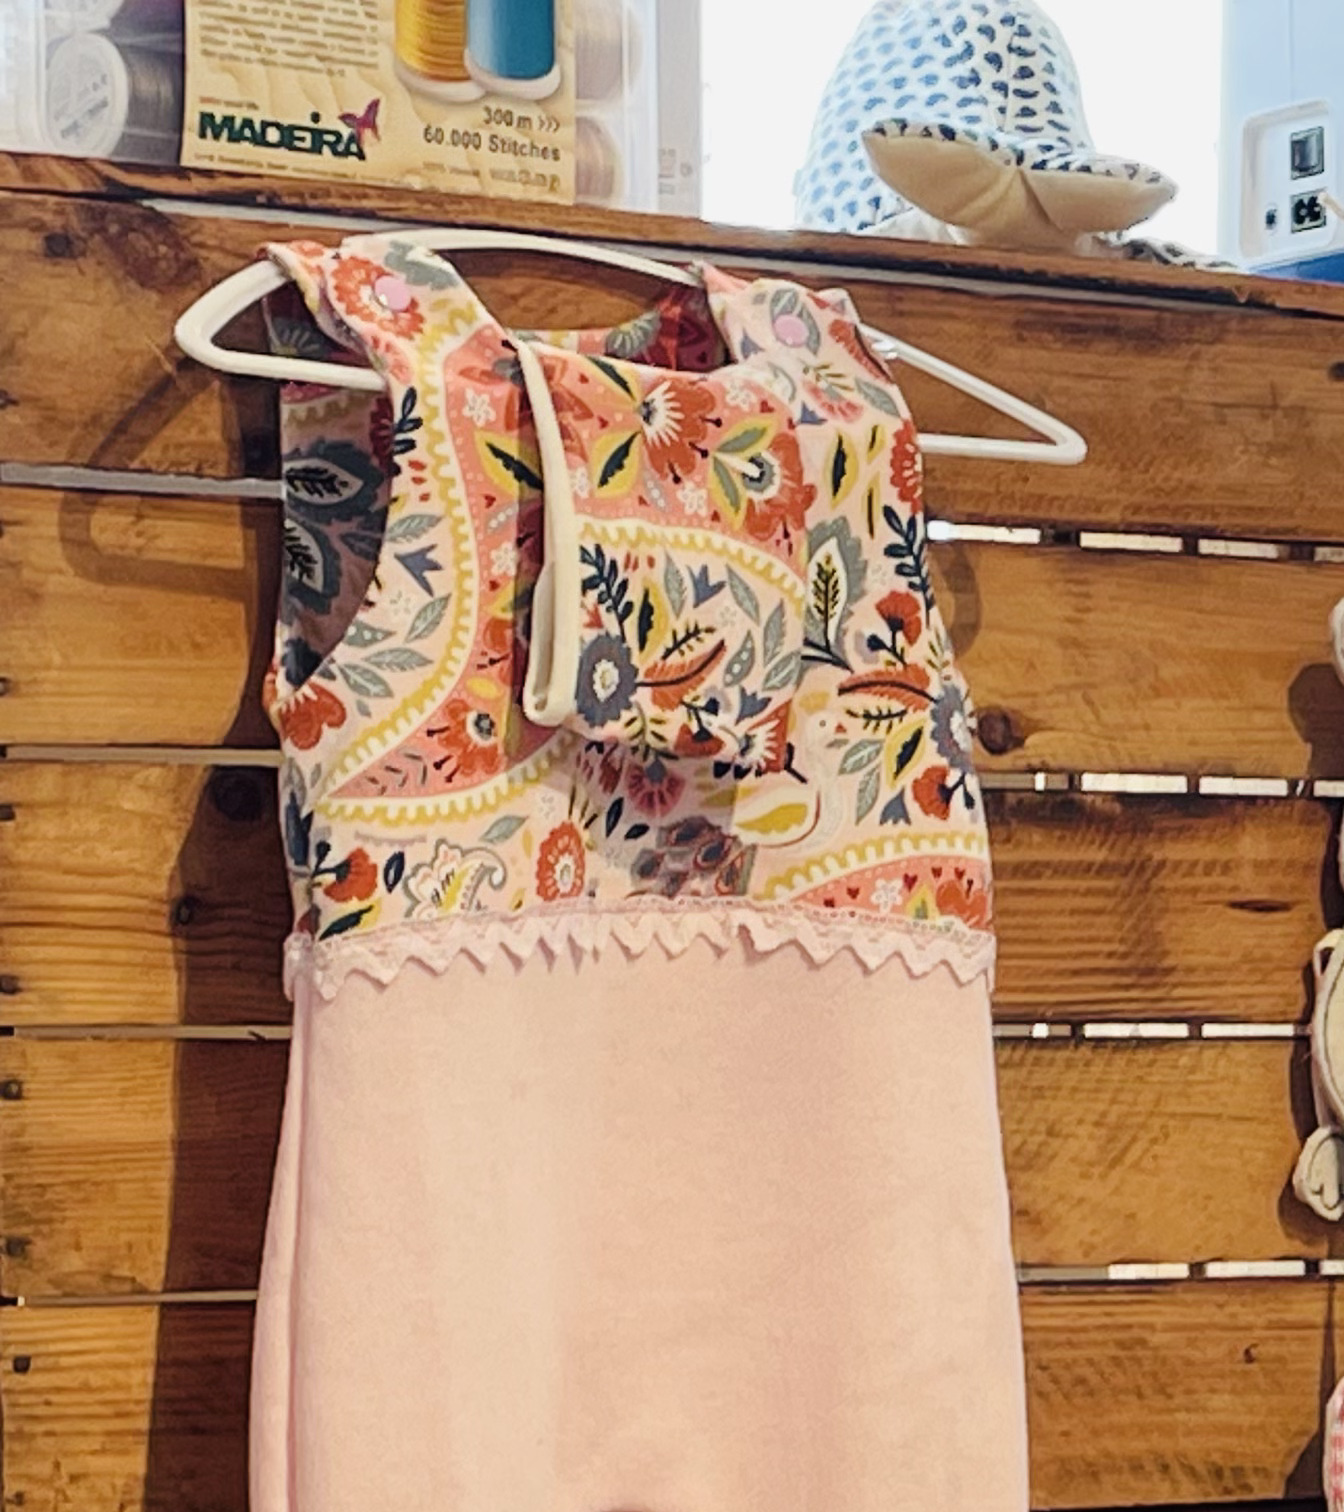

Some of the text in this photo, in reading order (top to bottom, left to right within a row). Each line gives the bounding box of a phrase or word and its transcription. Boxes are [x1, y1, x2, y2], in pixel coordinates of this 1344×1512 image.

[483, 106, 513, 127] 300
[198, 111, 367, 162] MADEIRA
[423, 124, 561, 162] 60.000 Stitches
